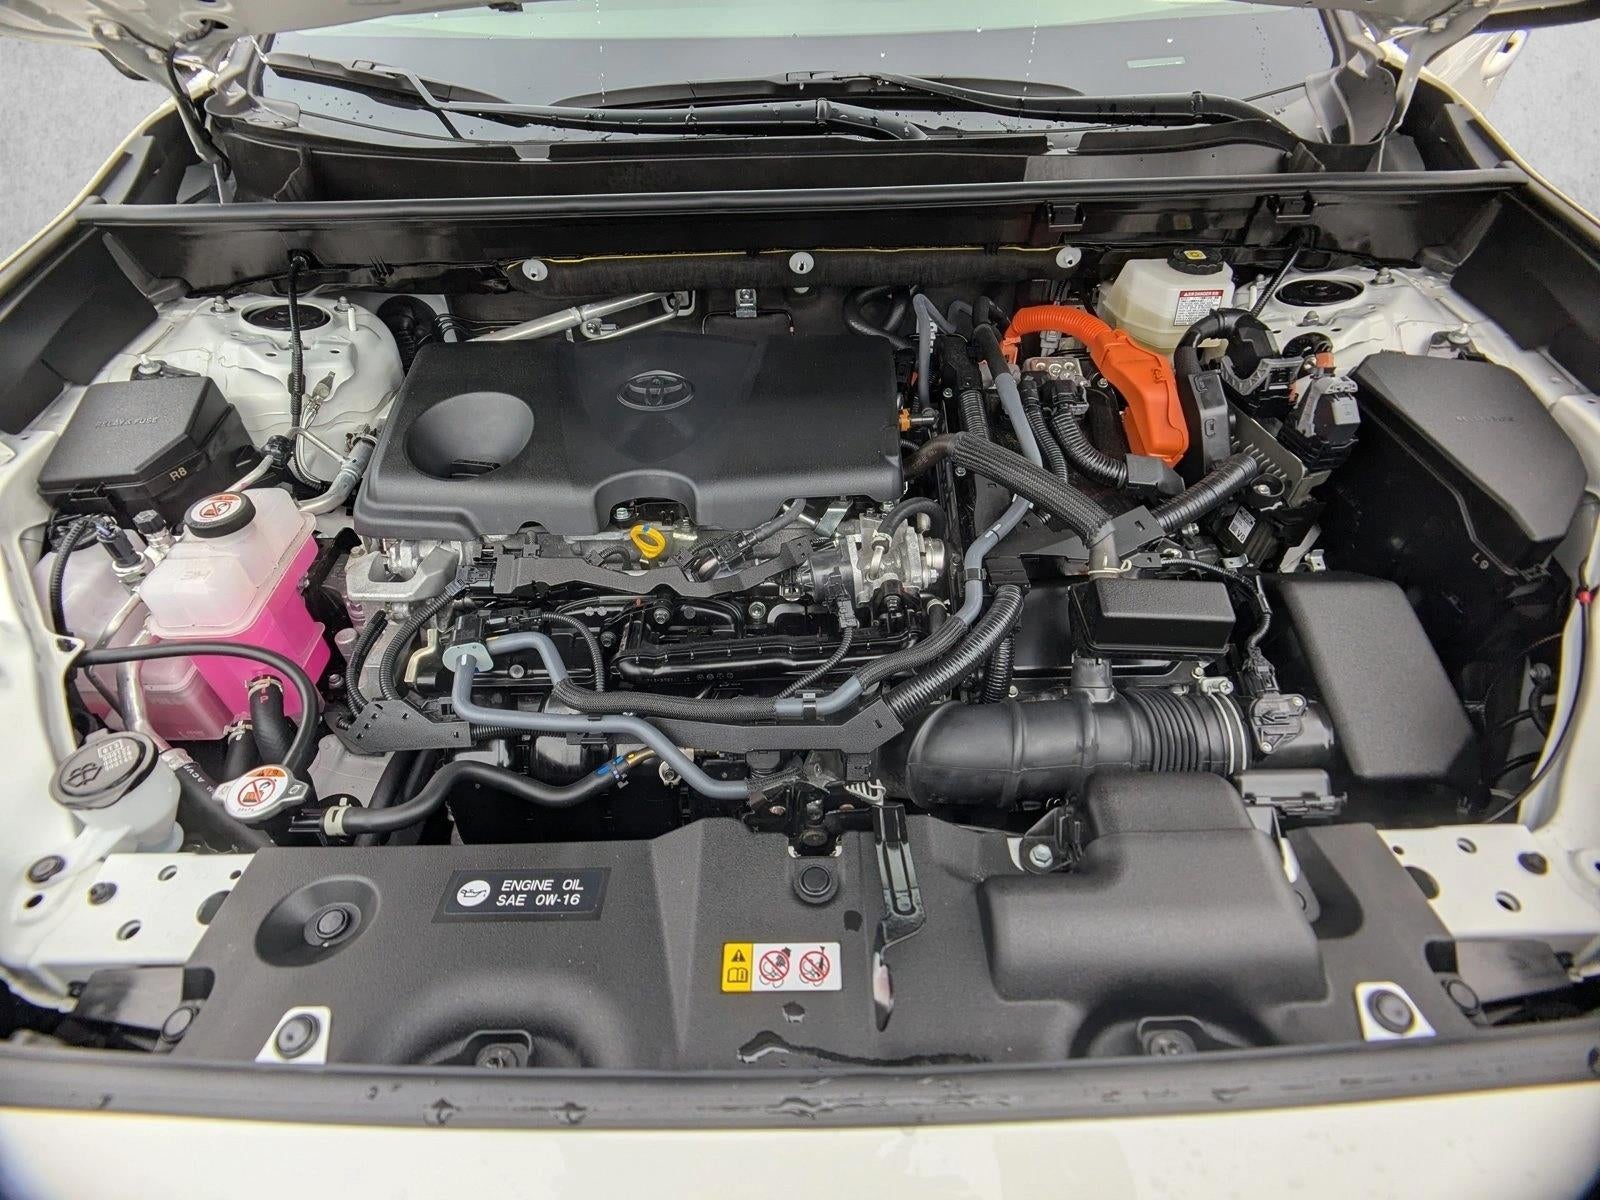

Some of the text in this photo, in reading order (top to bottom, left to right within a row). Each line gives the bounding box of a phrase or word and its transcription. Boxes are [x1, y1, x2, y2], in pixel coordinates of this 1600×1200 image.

[169, 467, 188, 481] R8
[501, 879, 584, 892] ENGINE OIL
[496, 893, 581, 906] SAE 0W-16
